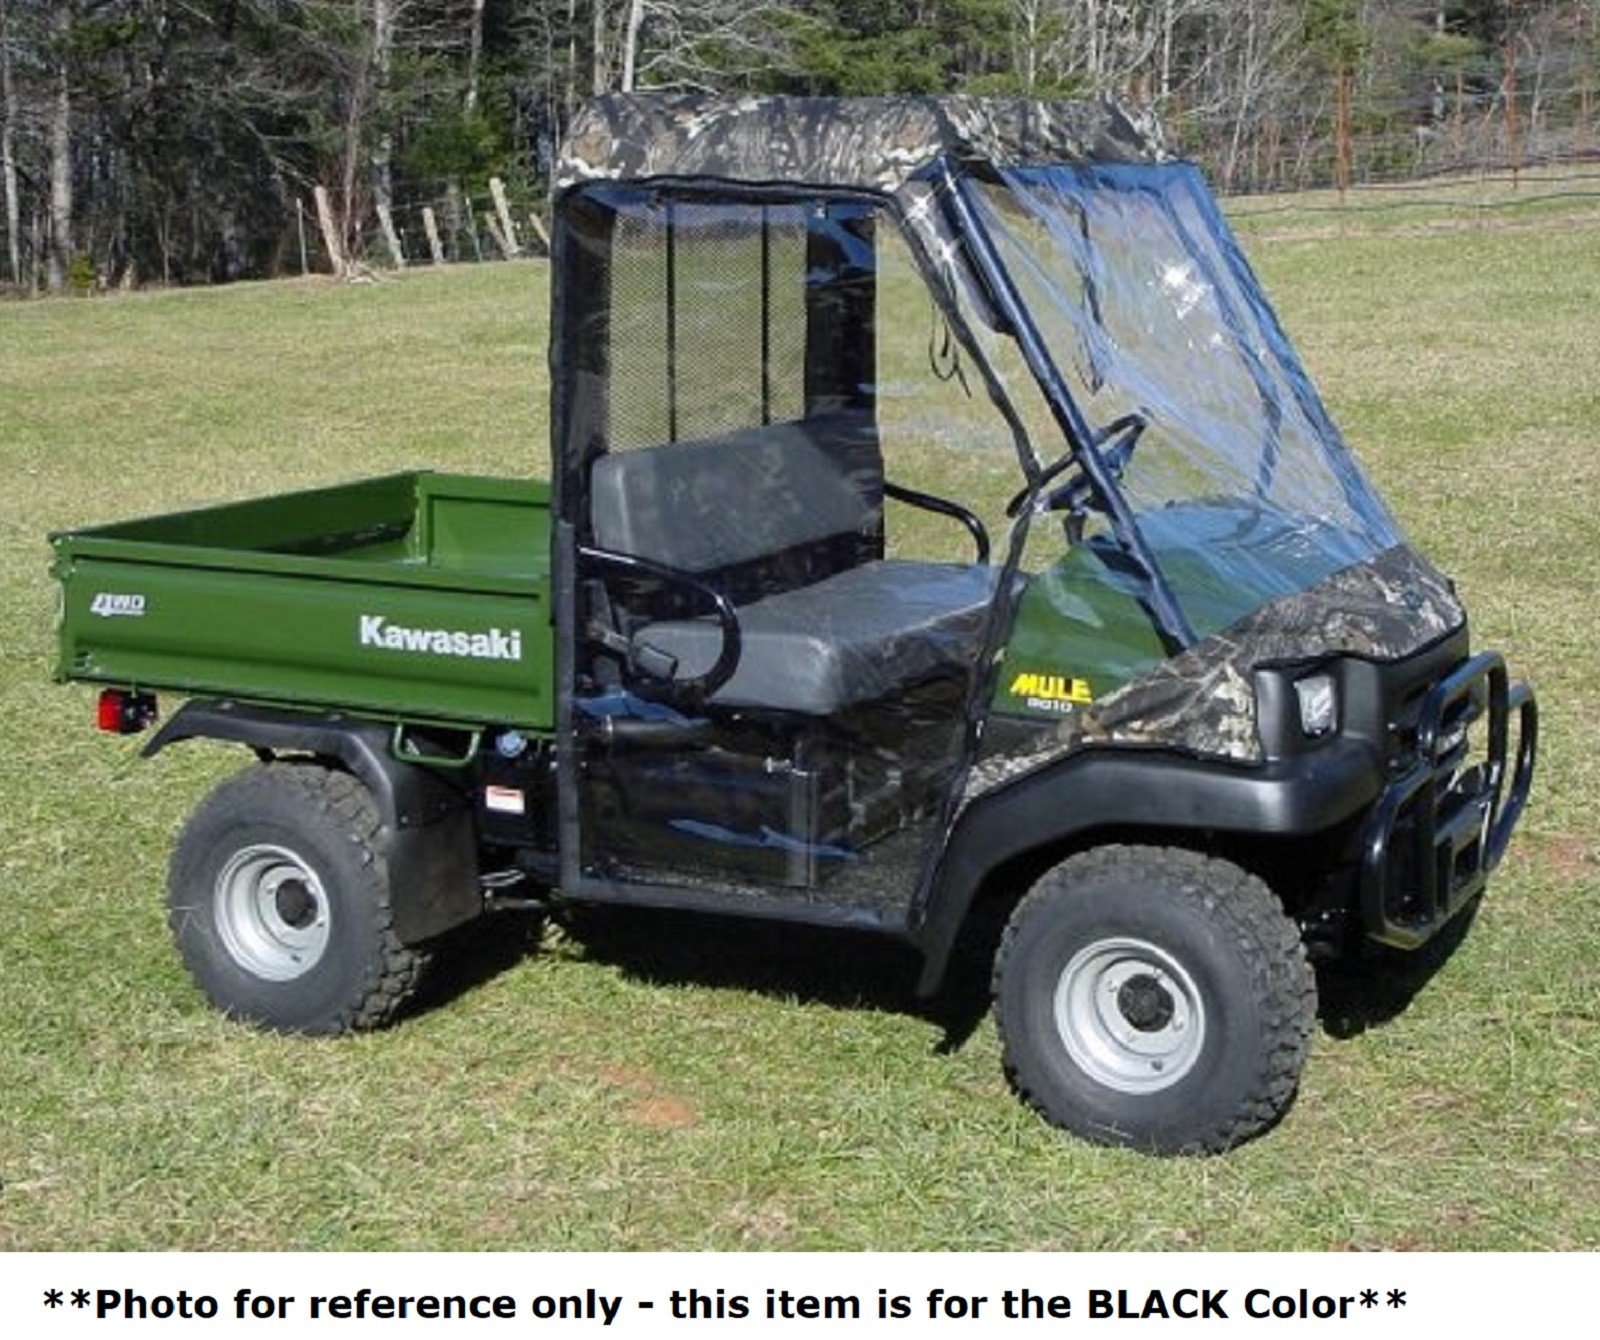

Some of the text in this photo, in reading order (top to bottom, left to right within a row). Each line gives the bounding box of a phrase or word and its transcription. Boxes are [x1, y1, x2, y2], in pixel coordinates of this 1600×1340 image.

[90, 592, 145, 616] 4WD
[360, 614, 522, 660] Kawasaki
[1010, 672, 1093, 704] MULE
